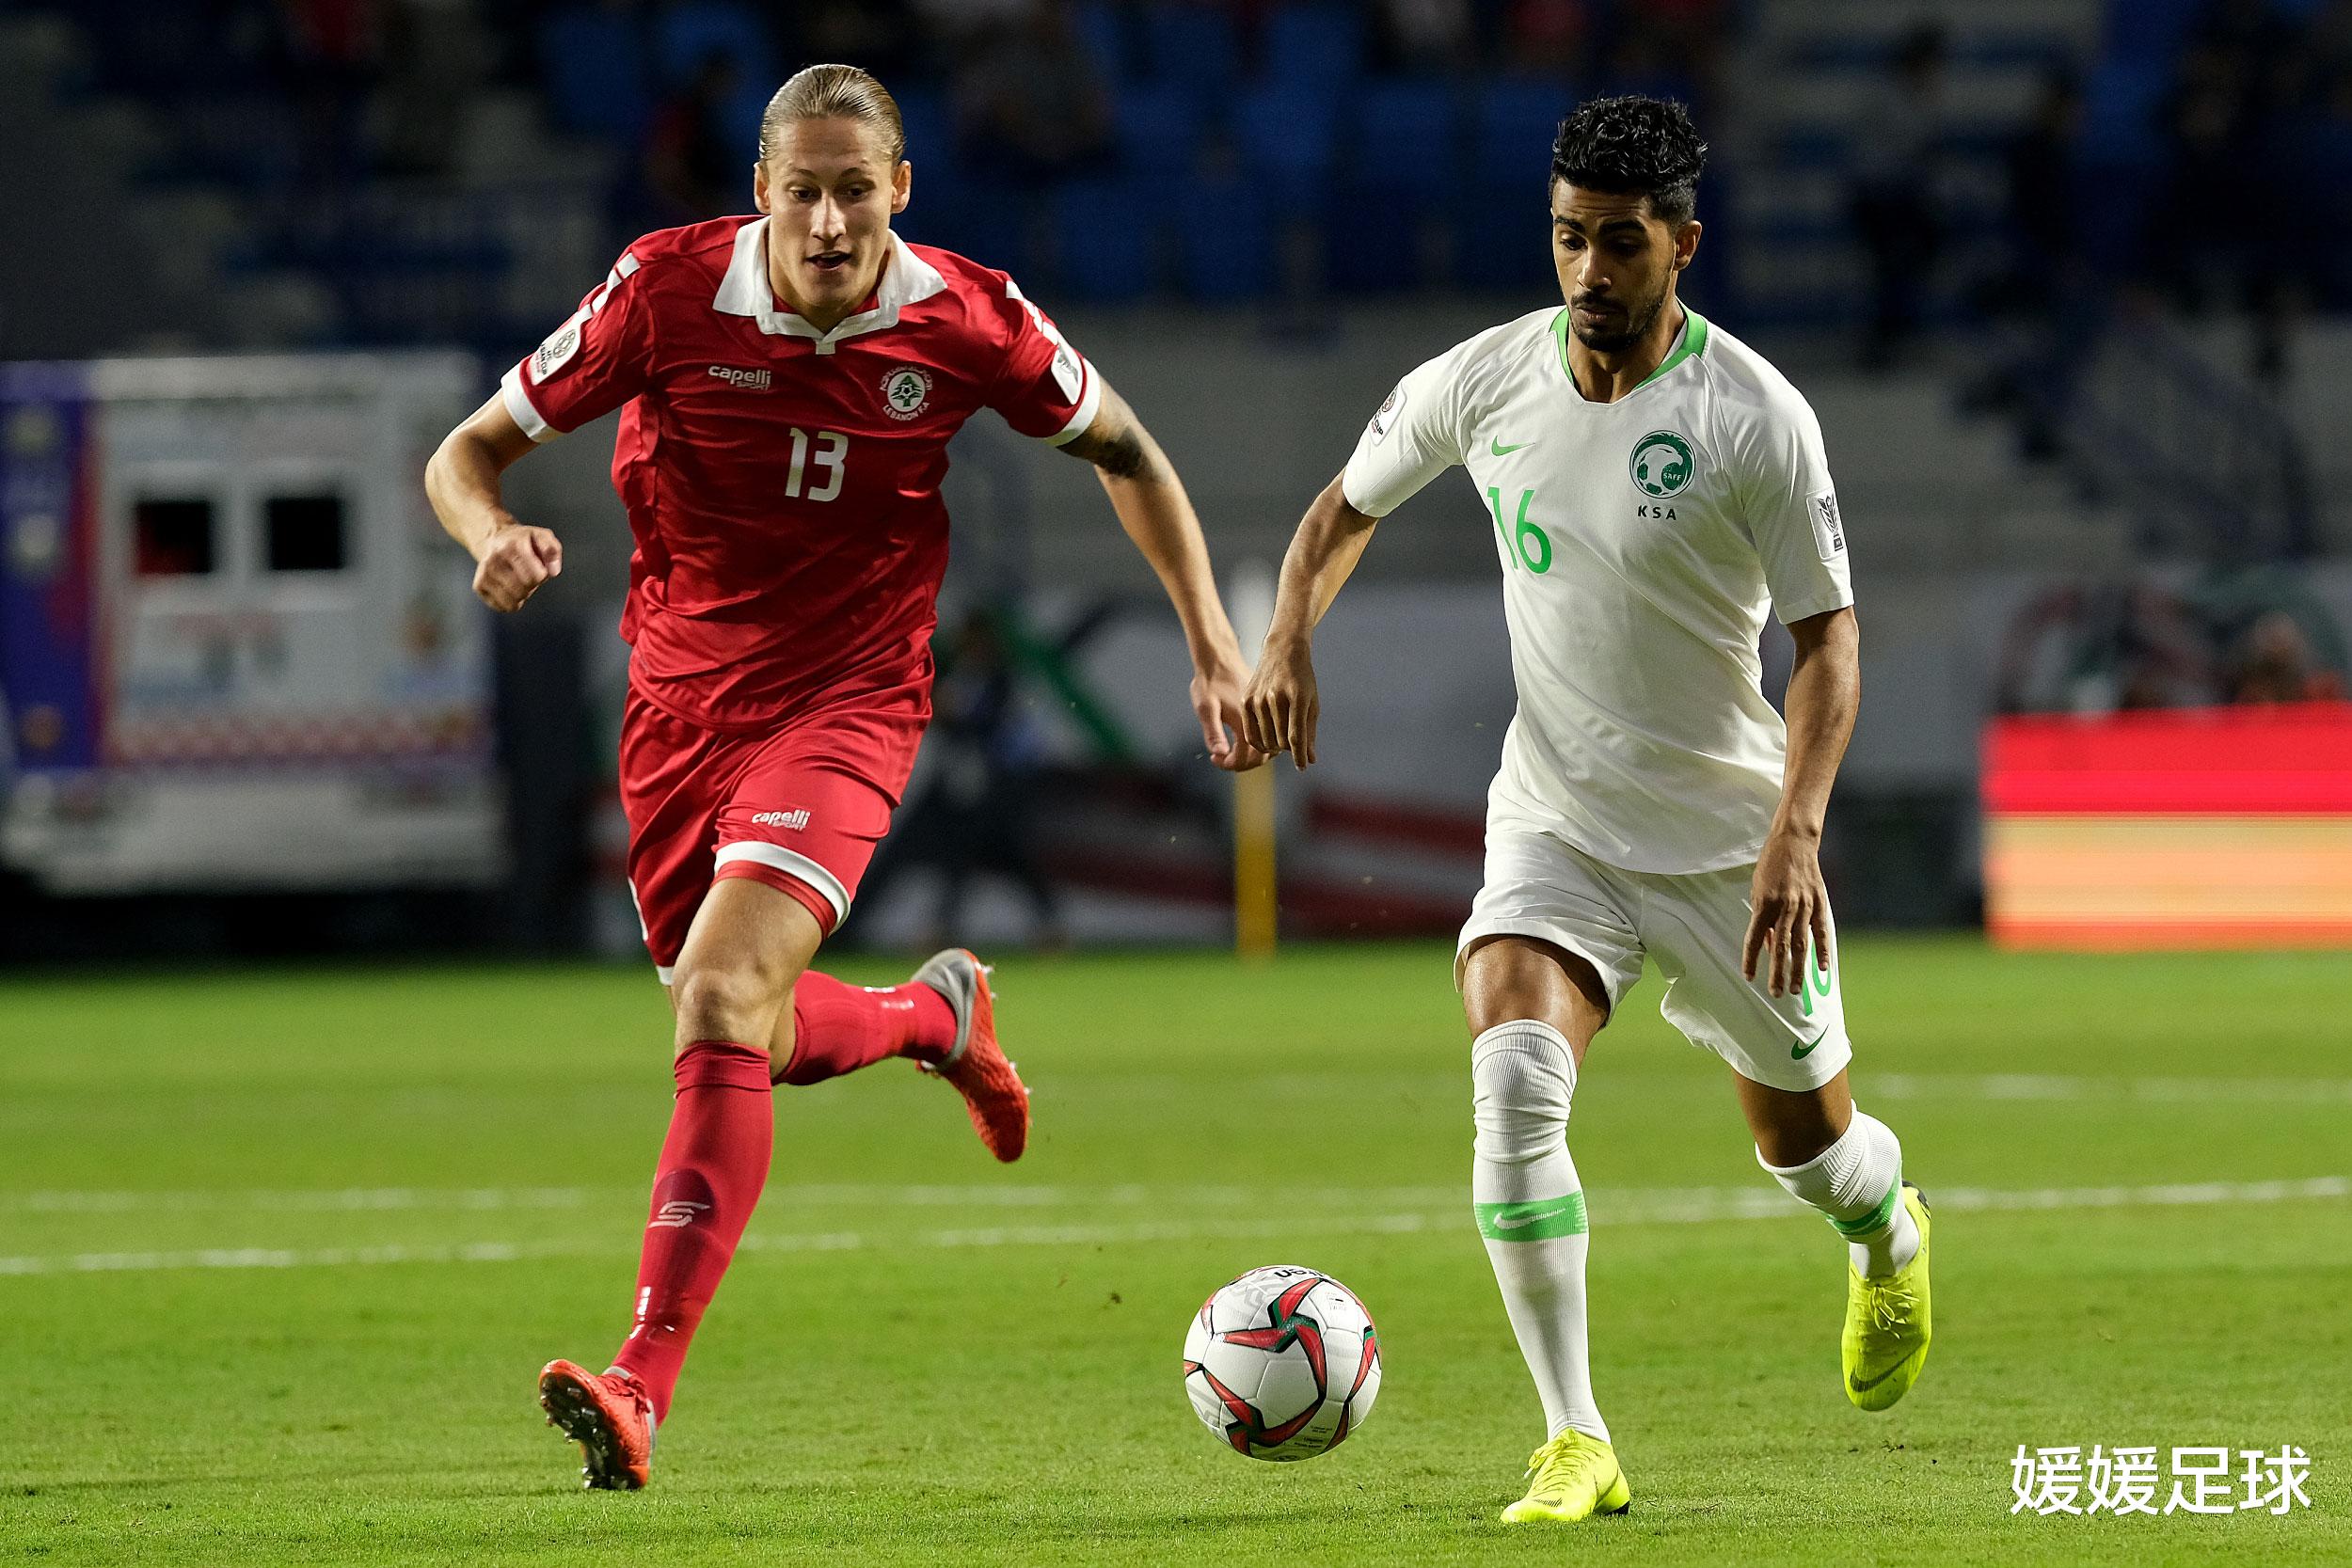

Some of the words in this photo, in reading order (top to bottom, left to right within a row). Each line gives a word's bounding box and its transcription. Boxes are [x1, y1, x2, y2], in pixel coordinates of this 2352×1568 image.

[708, 365, 771, 385] capelli
[785, 427, 849, 502] 13
[1662, 472, 1682, 482] SAFF
[1637, 504, 1677, 521] KSA
[1487, 485, 1552, 575] 16
[751, 809, 811, 827] capelli
